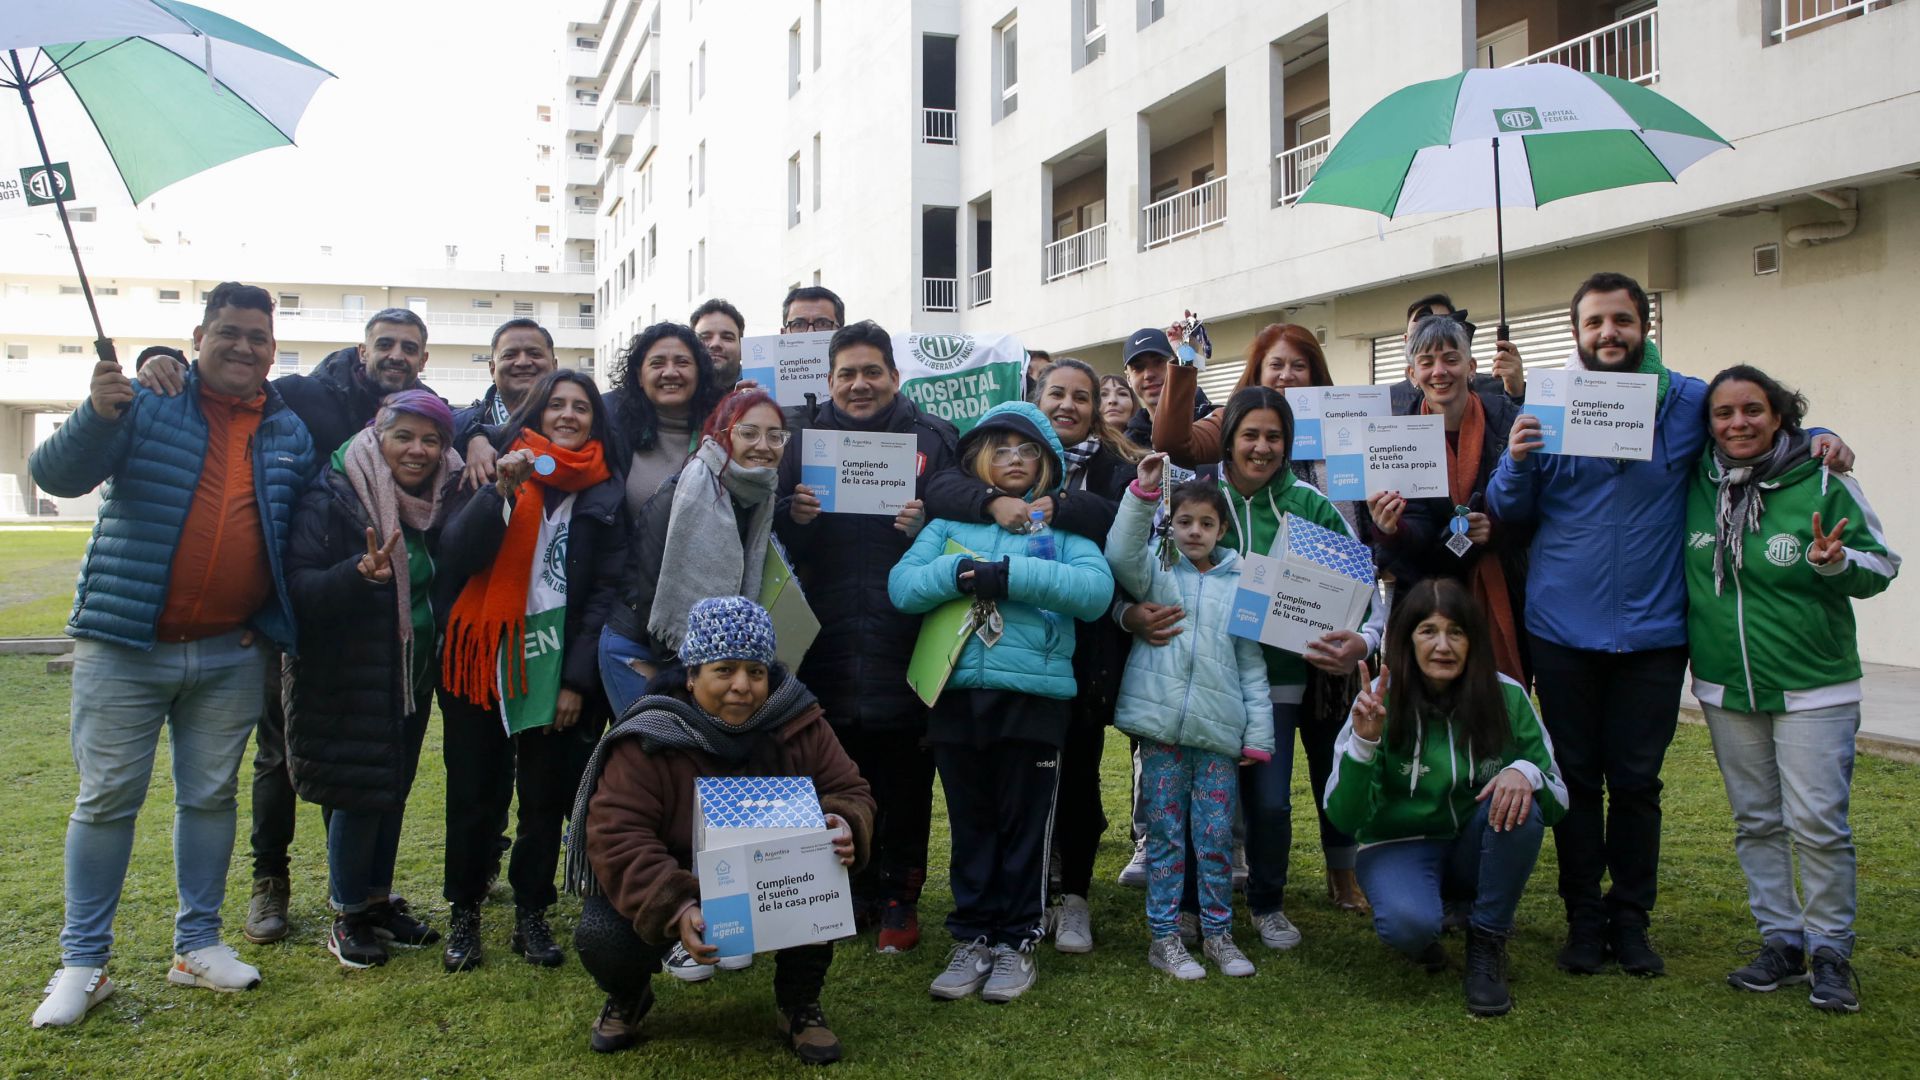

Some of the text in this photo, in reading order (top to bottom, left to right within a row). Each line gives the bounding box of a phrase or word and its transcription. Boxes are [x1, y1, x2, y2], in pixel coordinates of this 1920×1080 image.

[780, 358, 821, 366] Cumpliendo
[924, 360, 954, 370] LIBERAR
[954, 358, 963, 367] LA
[907, 371, 1000, 404] HOSPITAL
[926, 395, 990, 420] BORDA
[1573, 400, 1624, 410] Cumpliendo
[1582, 409, 1607, 418] sueño
[1616, 420, 1644, 429] propia
[1369, 444, 1417, 454] Cumpliendo
[1379, 452, 1403, 461] sueño
[842, 460, 889, 469] Cumpliendo
[1411, 460, 1436, 470] propia
[881, 479, 906, 487] propia
[1772, 541, 1794, 560] ATE
[1277, 592, 1321, 610] Cumpliendo
[1283, 603, 1305, 614] sueño
[1272, 608, 1282, 617] de
[1292, 614, 1308, 624] casa
[1309, 618, 1334, 631] propia
[756, 872, 815, 890] Cumpliendo
[758, 887, 798, 901] el sueño
[759, 890, 840, 912] de la casa propia
[719, 926, 744, 938] gente
